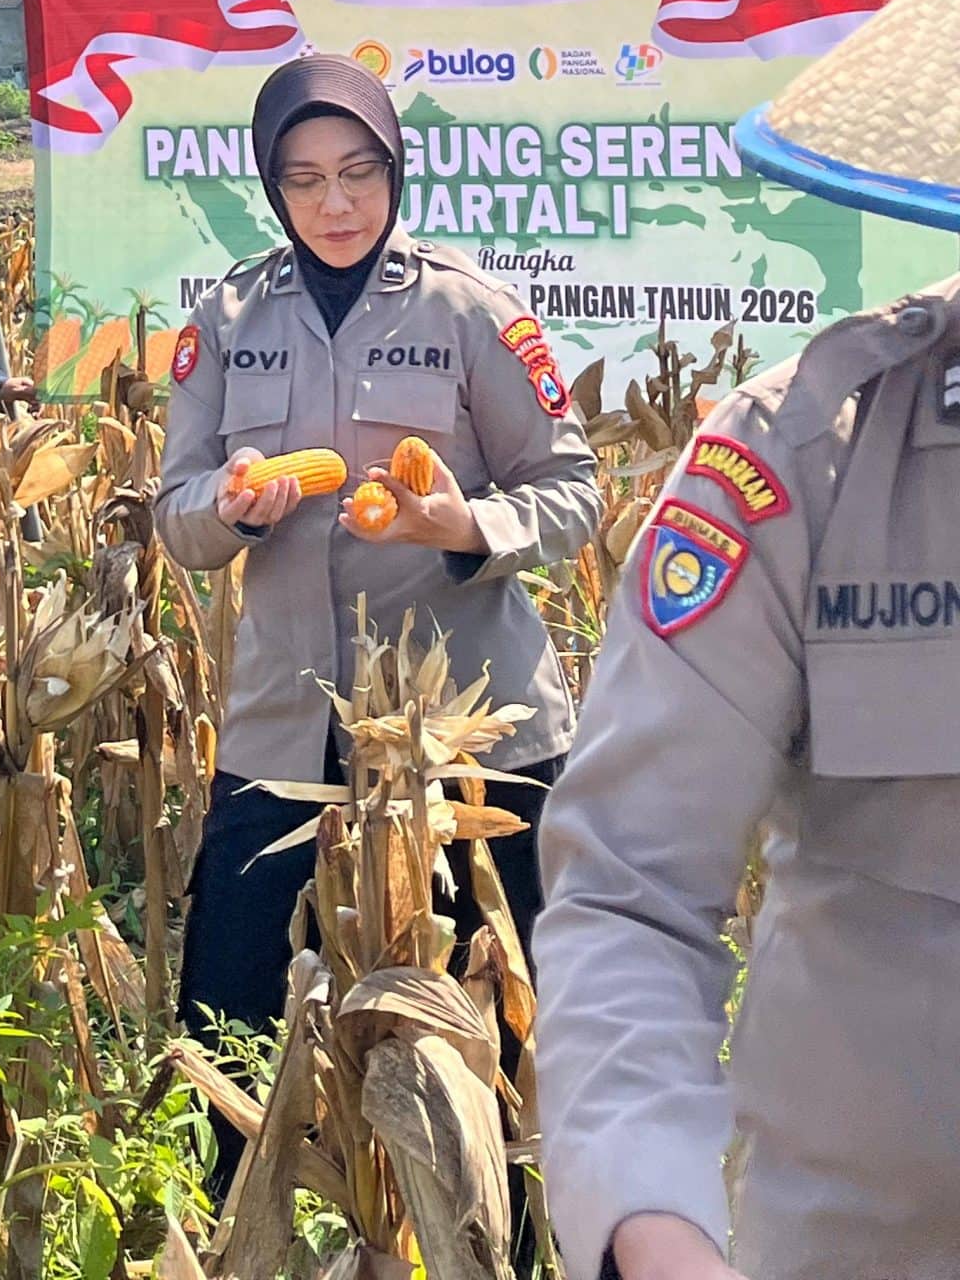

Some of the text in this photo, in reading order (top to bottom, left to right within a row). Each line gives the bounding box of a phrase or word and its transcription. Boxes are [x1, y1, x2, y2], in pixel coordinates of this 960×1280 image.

[428, 48, 515, 81] bulog
[560, 50, 591, 58] BADAN
[561, 58, 597, 67] PANGAN
[561, 67, 607, 76] NASIONAL
[403, 124, 542, 178] GUNG
[559, 124, 743, 178] SEREN
[400, 183, 628, 235] UARTAL I
[478, 246, 576, 279] Rangka
[530, 284, 815, 325] PANGAN TAHUN 2026
[367, 345, 451, 370] POLRI
